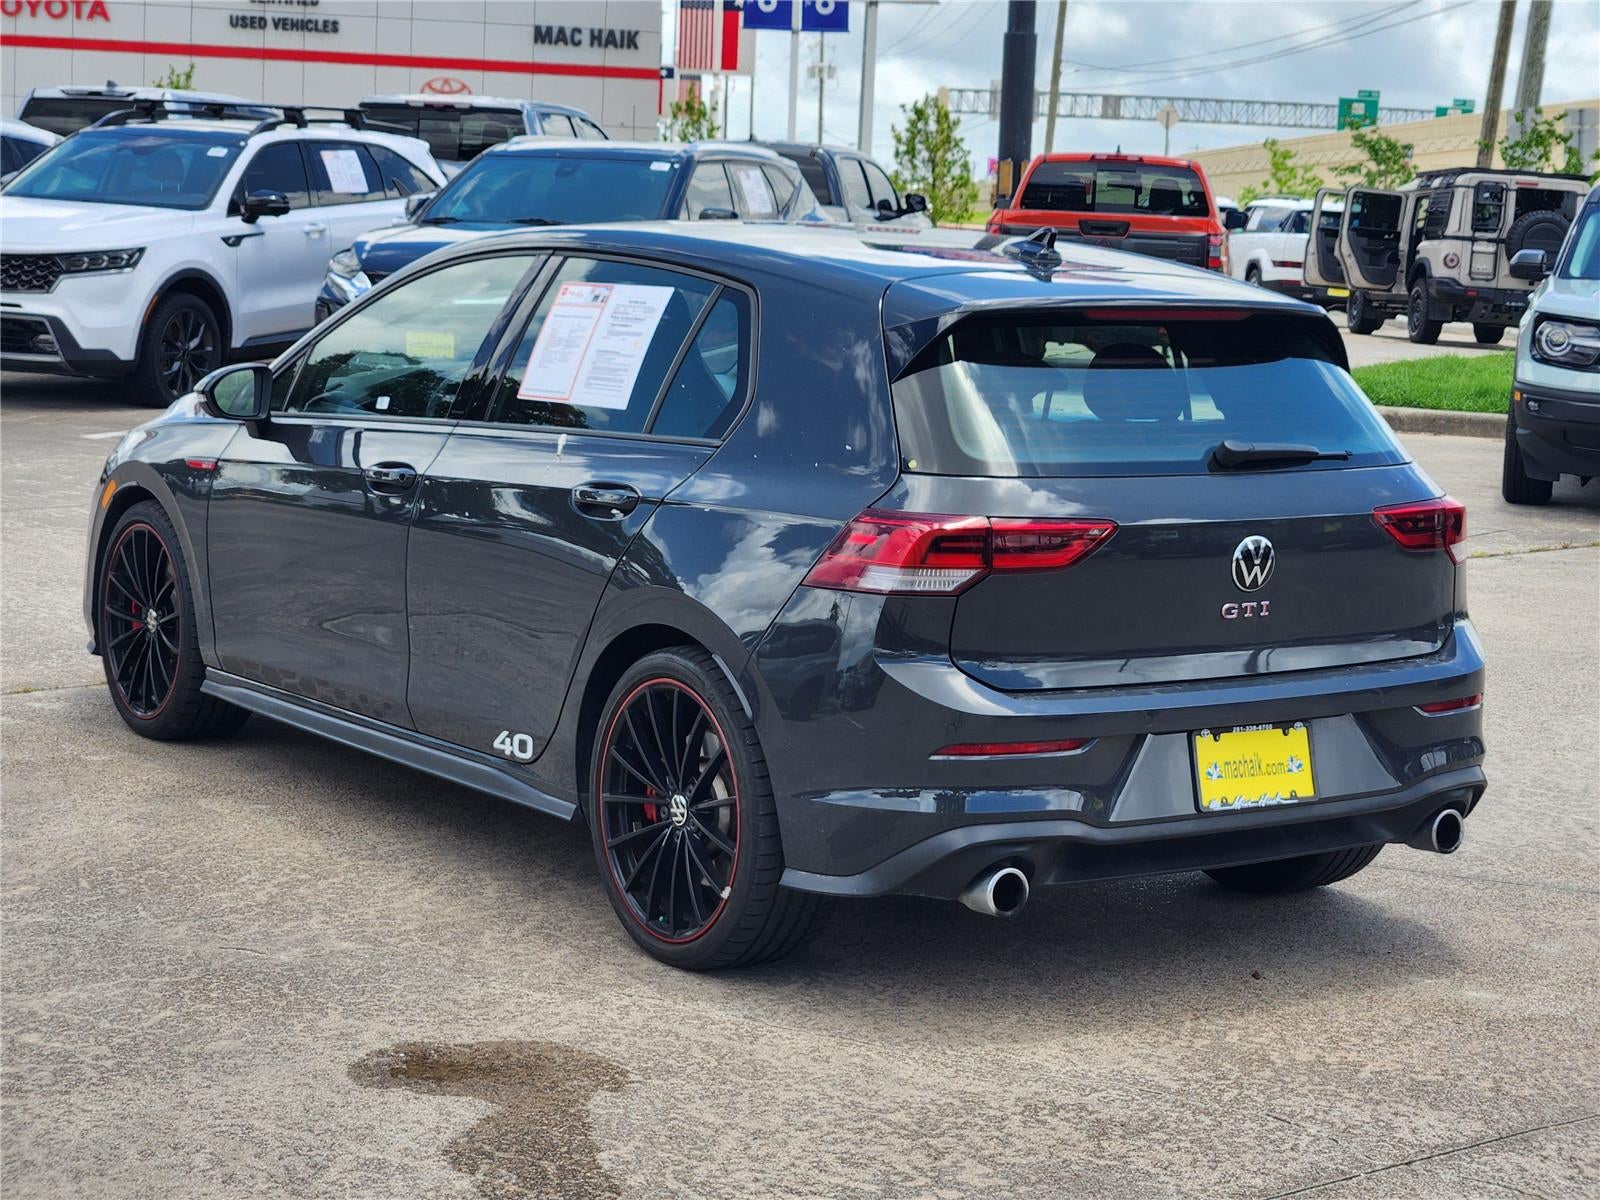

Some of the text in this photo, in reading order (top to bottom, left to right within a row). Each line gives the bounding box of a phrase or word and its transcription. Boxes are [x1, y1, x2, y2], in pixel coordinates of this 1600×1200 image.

[229, 14, 340, 33] USED VEHICLES
[533, 25, 640, 50] MAC HAIK
[1221, 600, 1270, 619] GTI
[493, 730, 534, 760] 40
[1224, 752, 1287, 779] machaik.com
